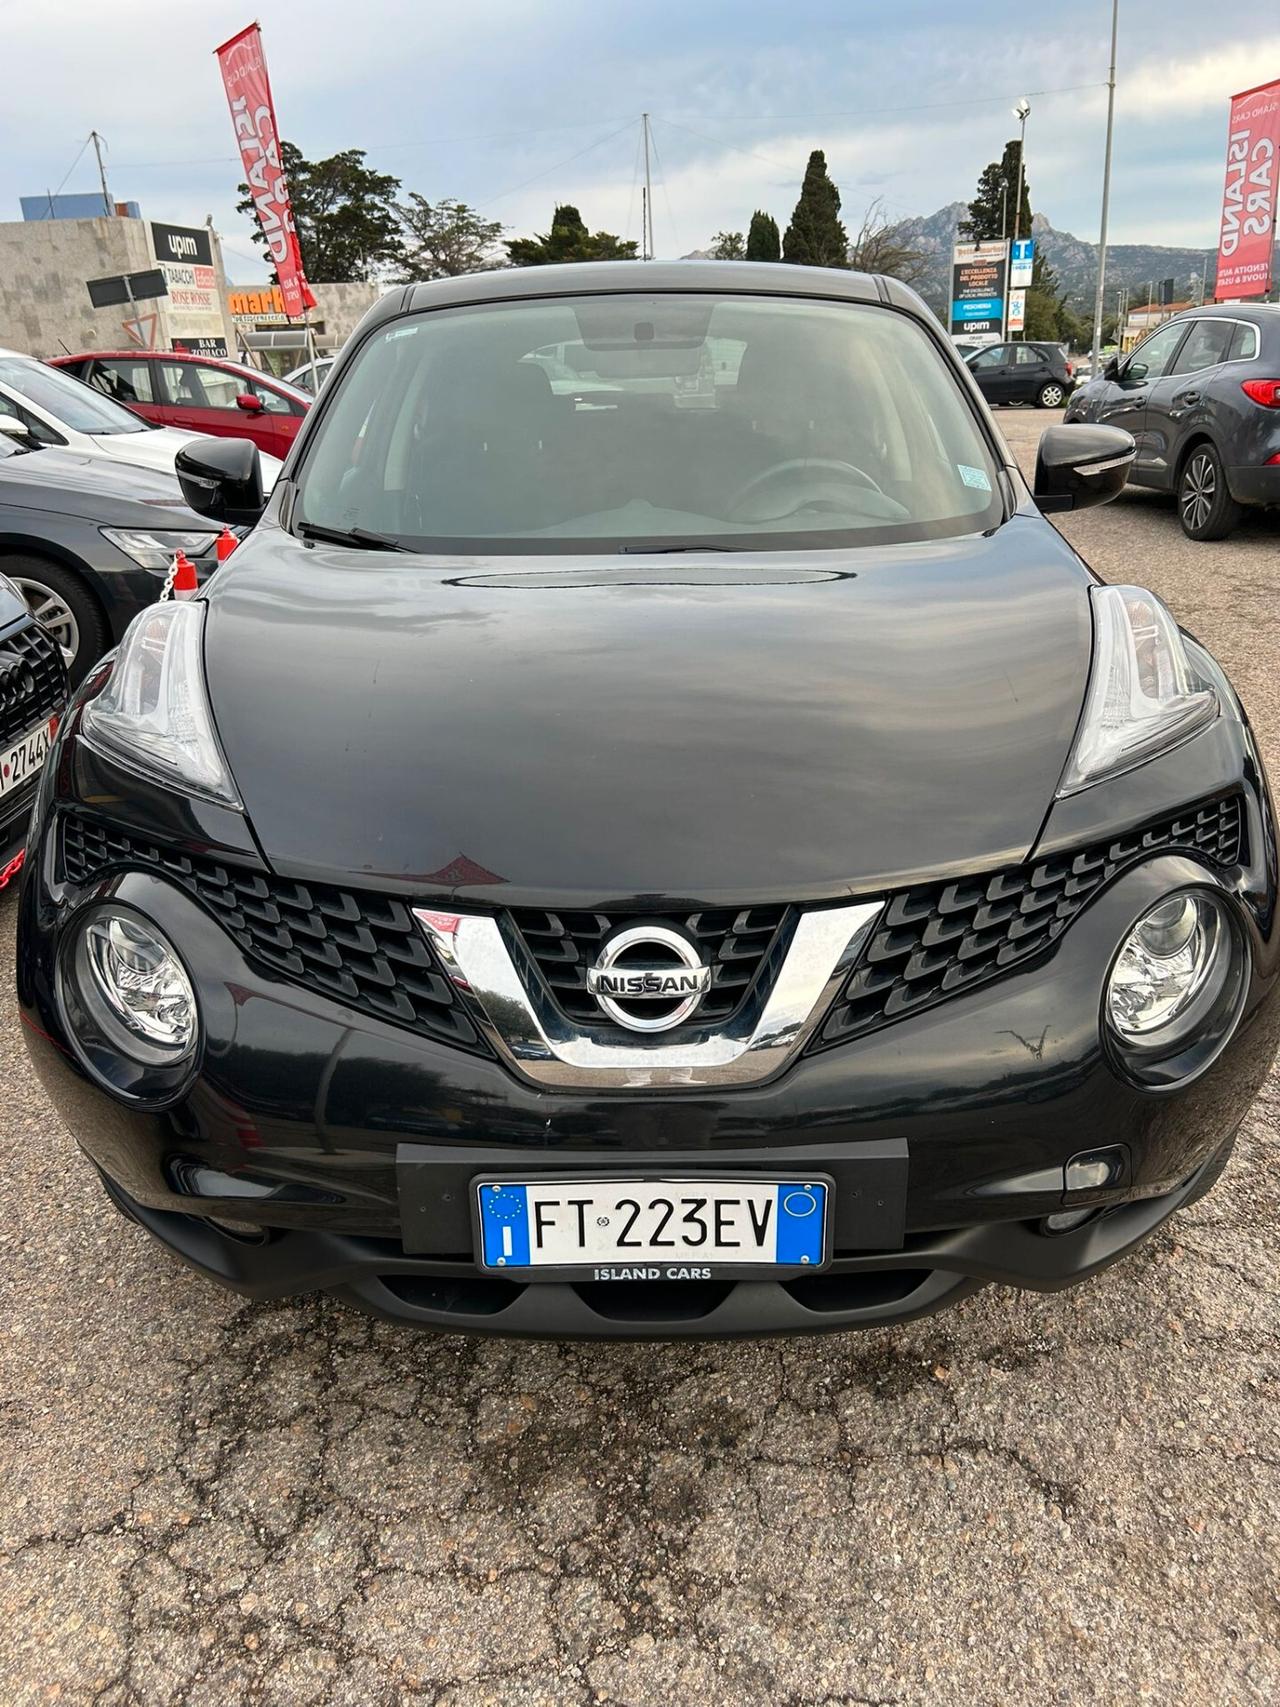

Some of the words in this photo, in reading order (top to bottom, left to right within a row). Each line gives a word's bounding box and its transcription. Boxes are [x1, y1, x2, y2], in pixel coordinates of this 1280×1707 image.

[168, 234, 198, 259] upim
[171, 290, 190, 305] ROSE
[964, 322, 990, 333] upim
[199, 339, 217, 348] BAR
[191, 348, 228, 358] ZODIACO
[596, 973, 699, 993] NISSAN
[534, 1200, 594, 1248] FT
[614, 1199, 774, 1247] 223EV
[594, 1268, 661, 1281] ISLAND
[667, 1267, 712, 1280] CARS
